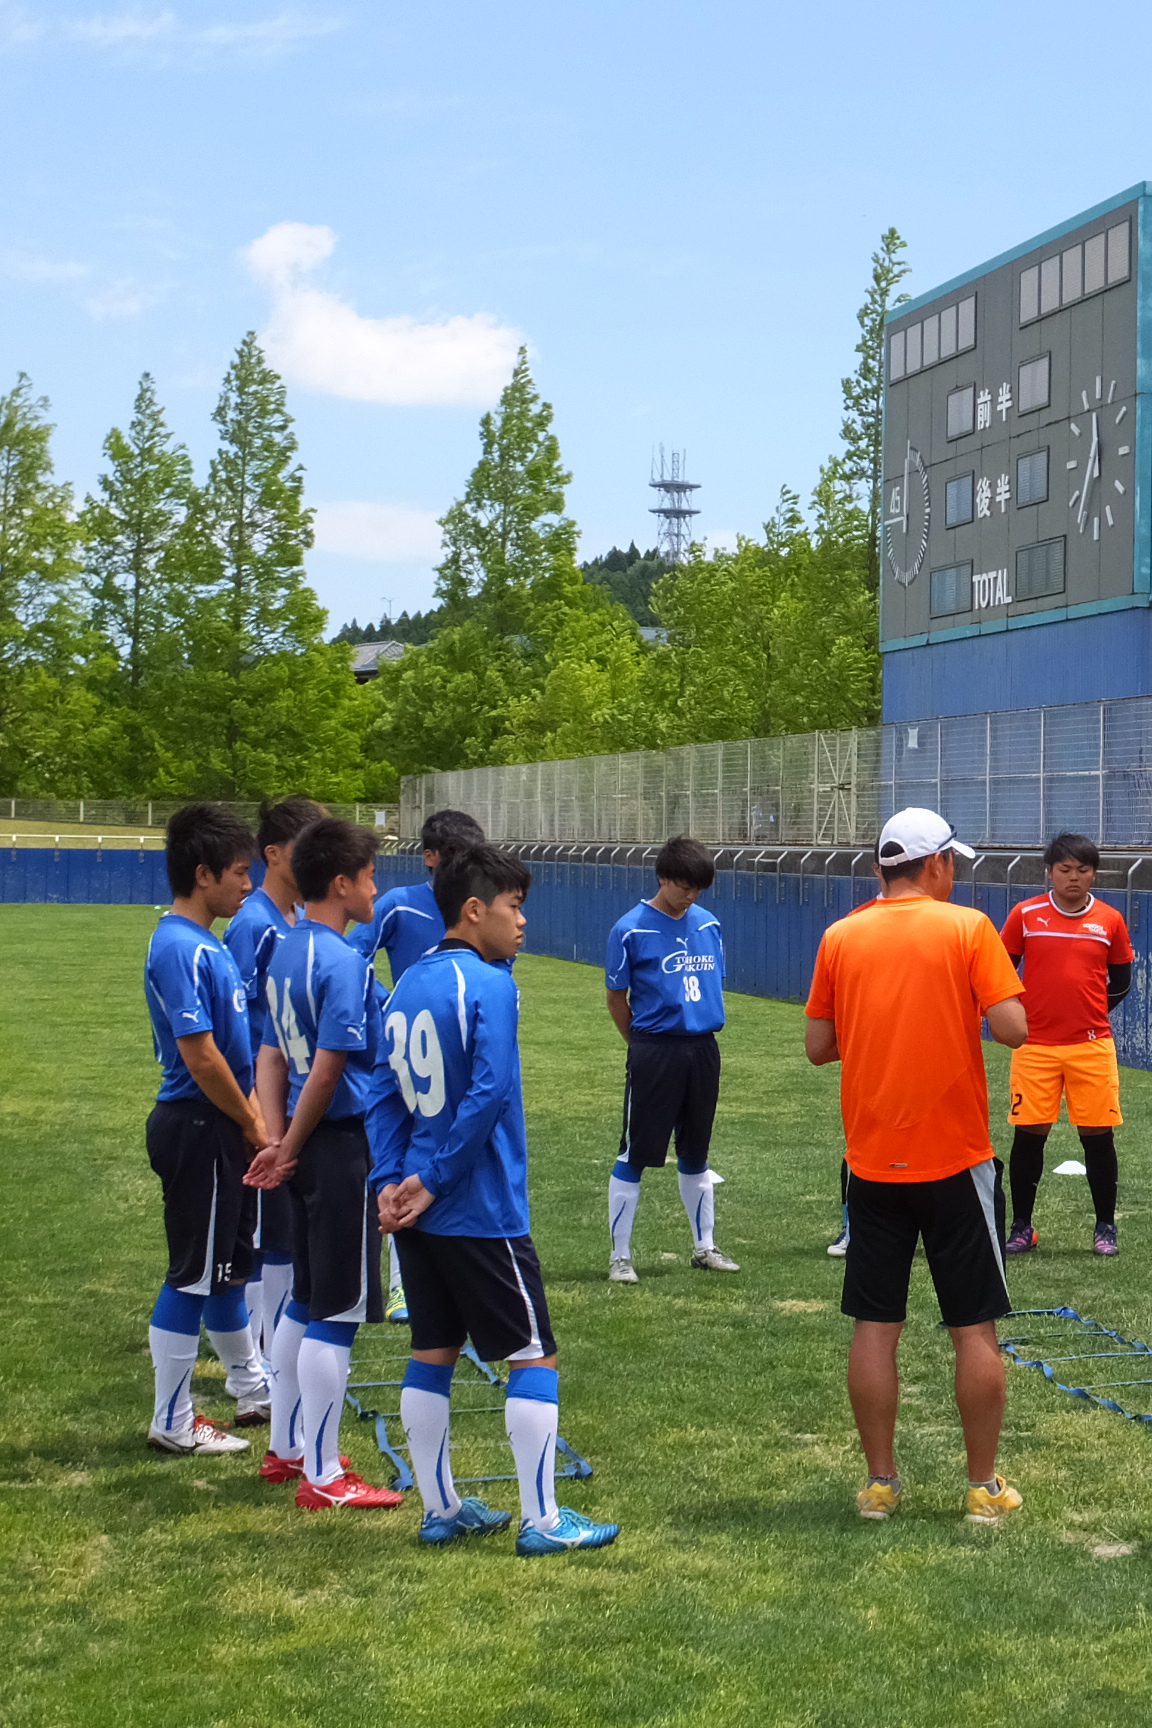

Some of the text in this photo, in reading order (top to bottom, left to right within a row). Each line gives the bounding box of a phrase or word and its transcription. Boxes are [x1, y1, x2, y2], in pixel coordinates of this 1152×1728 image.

[977, 382, 1012, 430] 前半
[890, 486, 900, 514] 45
[976, 474, 1011, 518] 後半
[972, 568, 1012, 610] TOTAL
[384, 1009, 446, 1117] 39
[217, 1262, 232, 1283] 15
